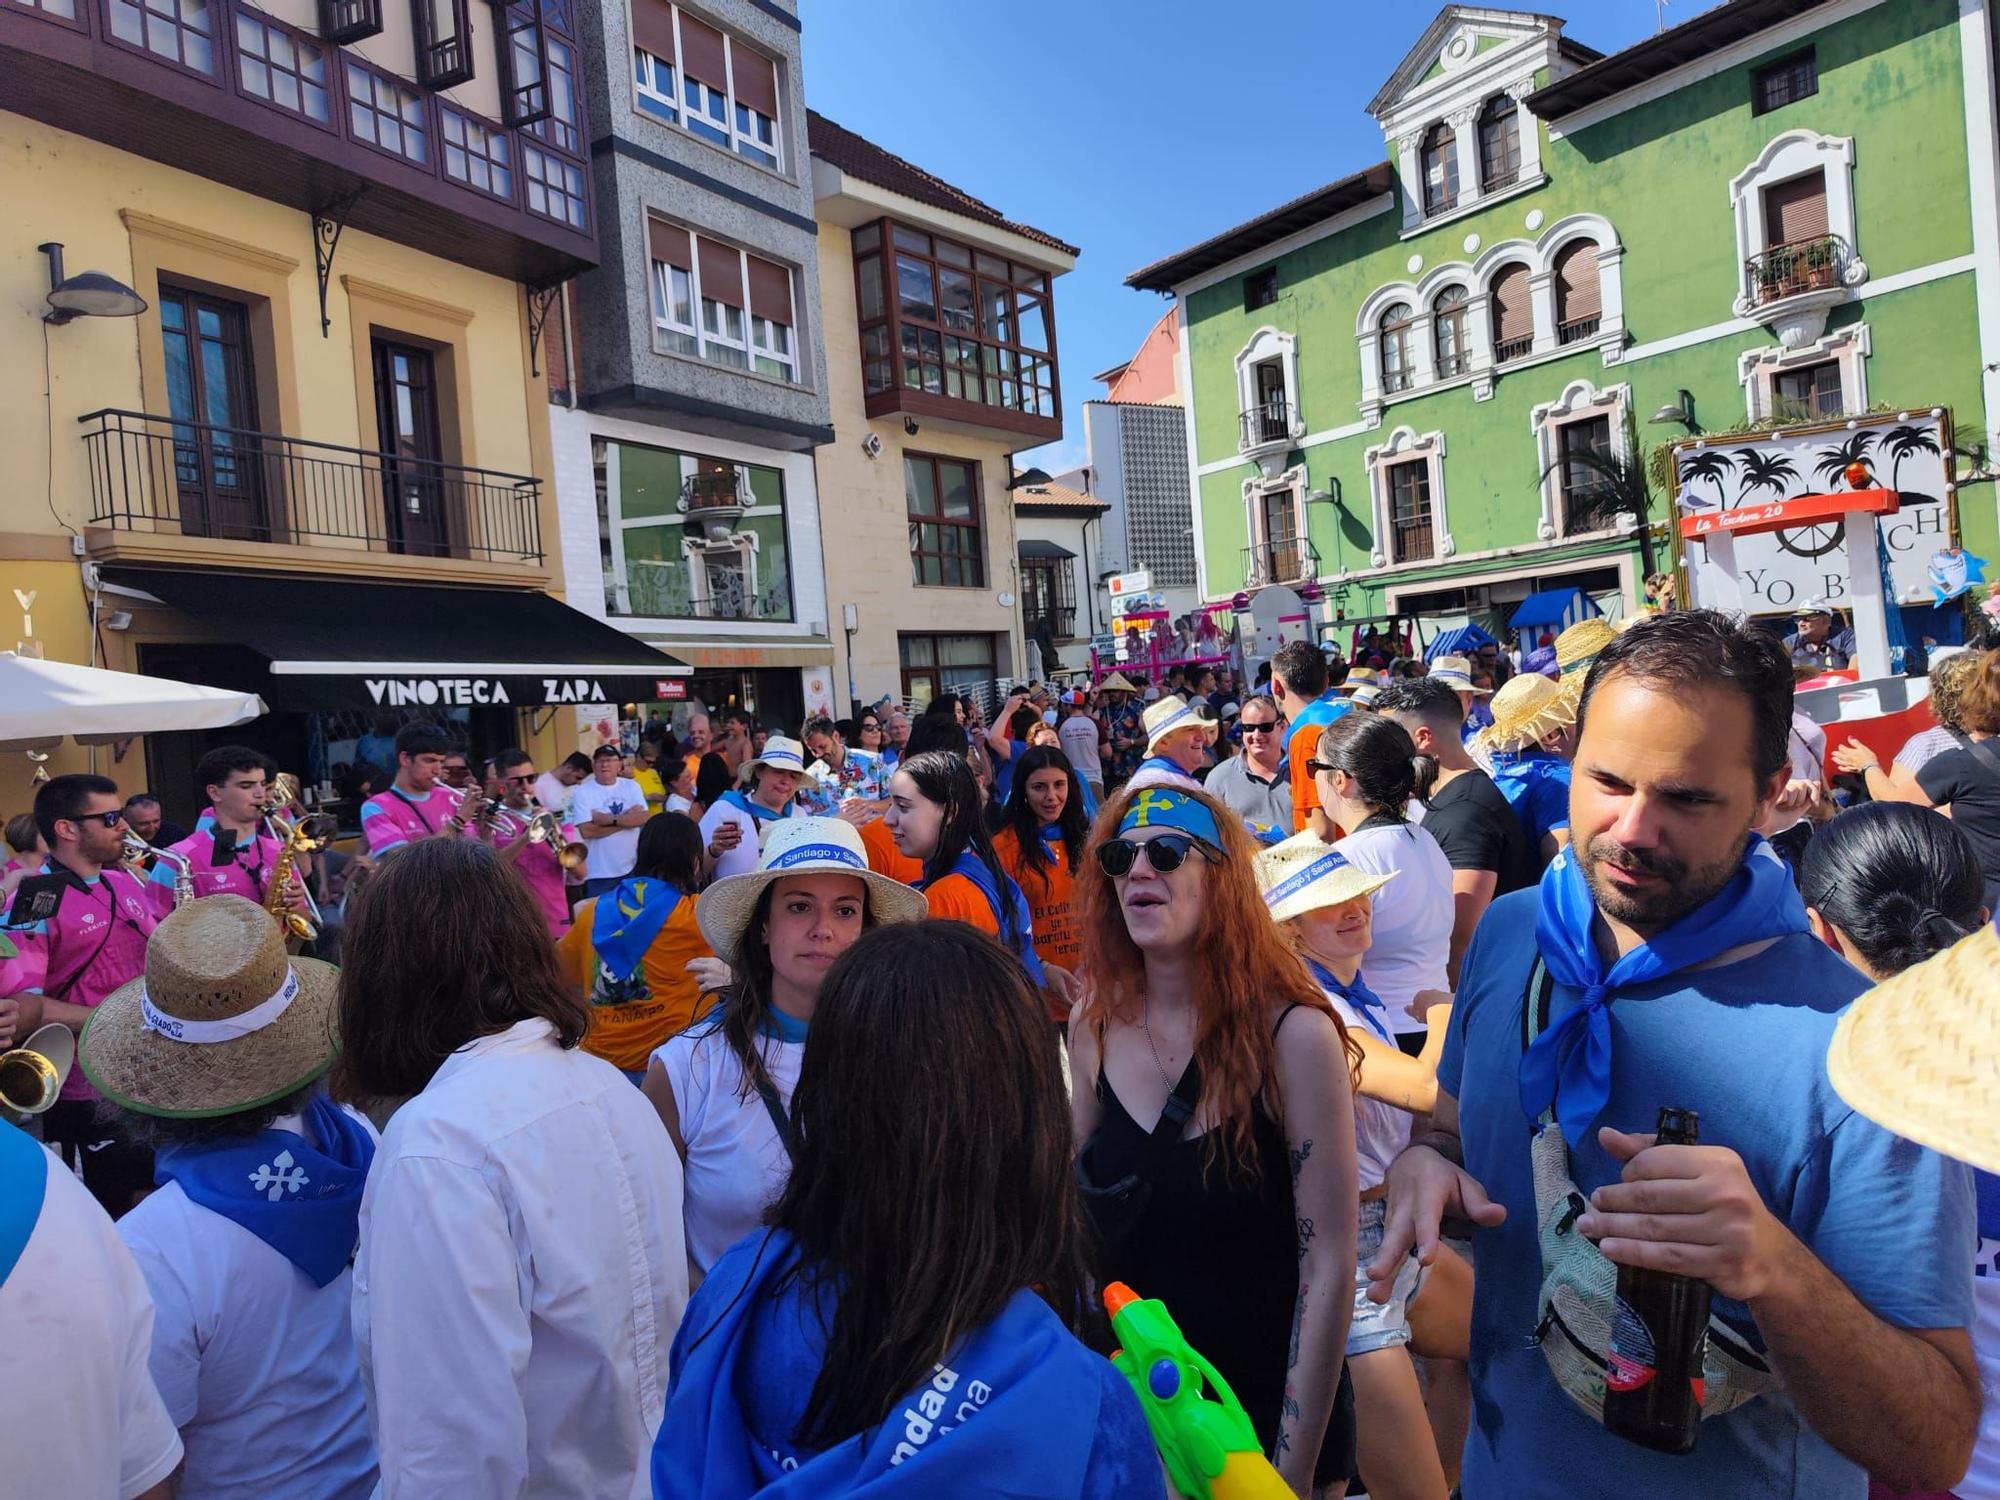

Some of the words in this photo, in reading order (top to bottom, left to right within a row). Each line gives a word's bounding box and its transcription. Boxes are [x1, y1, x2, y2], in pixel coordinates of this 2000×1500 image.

[1822, 508, 1943, 599] BCH
[365, 680, 510, 705] VINOTECA
[543, 679, 606, 702] ZAPA
[785, 848, 831, 864] Santiago
[833, 850, 840, 859] y
[1277, 876, 1305, 895] Santiago
[1305, 871, 1312, 882] y
[890, 1363, 959, 1467] ndad
